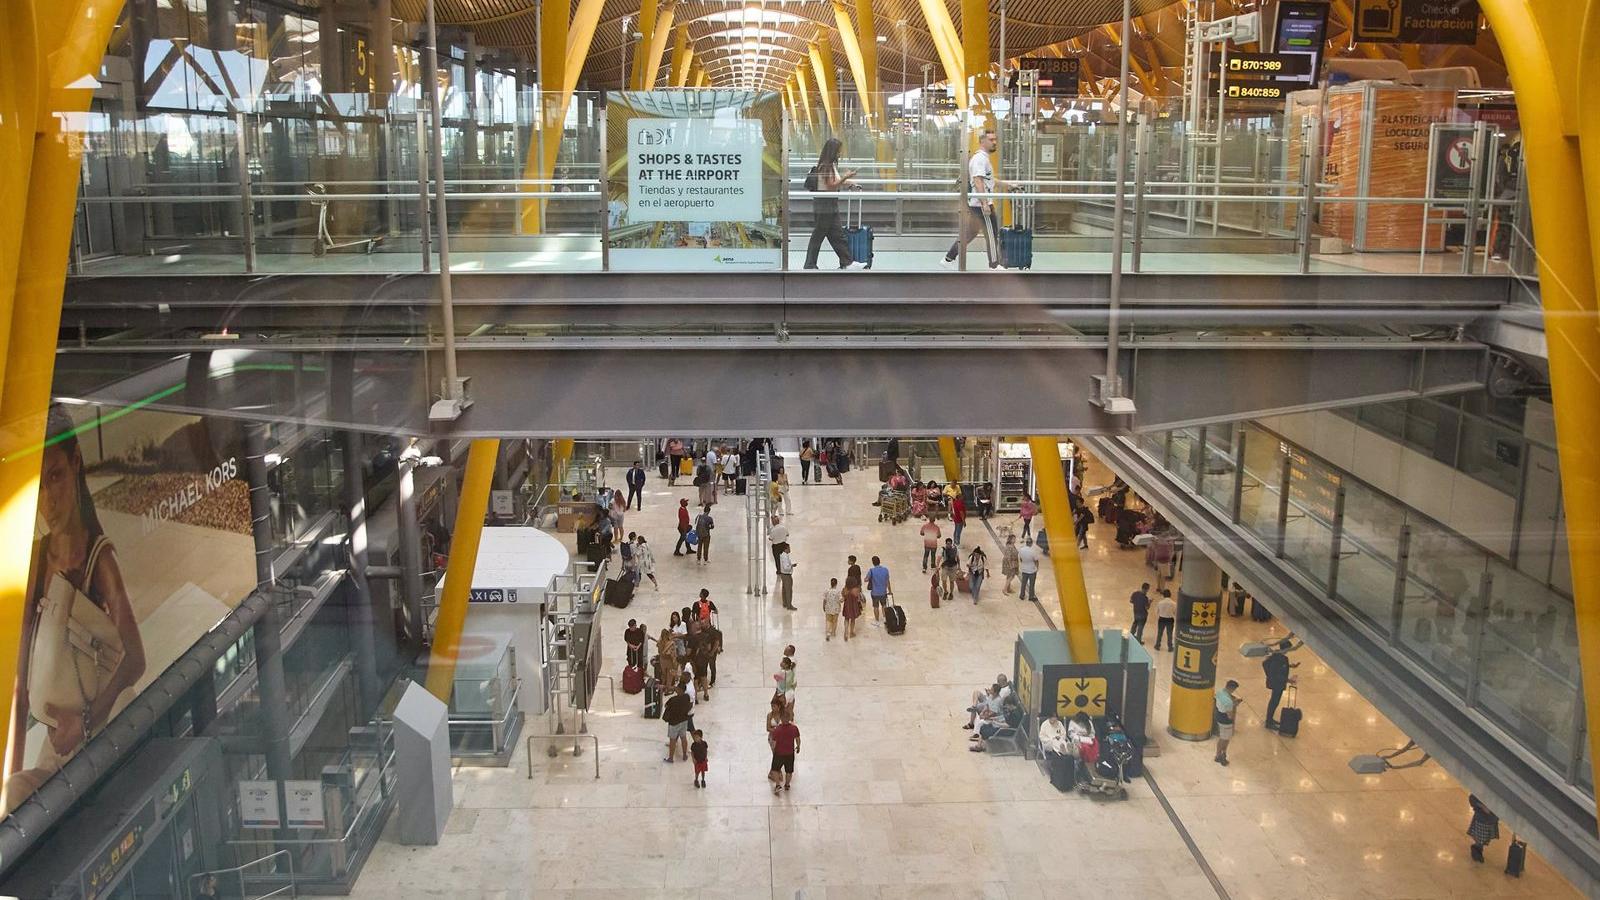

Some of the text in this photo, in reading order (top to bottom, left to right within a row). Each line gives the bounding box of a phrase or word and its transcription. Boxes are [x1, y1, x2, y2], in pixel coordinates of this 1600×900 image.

[1404, 17, 1473, 30] Facturación
[358, 39, 366, 76] 5
[1385, 128, 1430, 138] LOCALIZAD
[638, 153, 742, 165] SHOPS & TASTES
[638, 169, 740, 181] AT THE AIRPORT
[639, 185, 744, 197] Tiendas y restaurantes
[638, 198, 715, 209] en el aeropuerto
[141, 456, 237, 536] MICHAEL KORS
[468, 591, 487, 601] AXI
